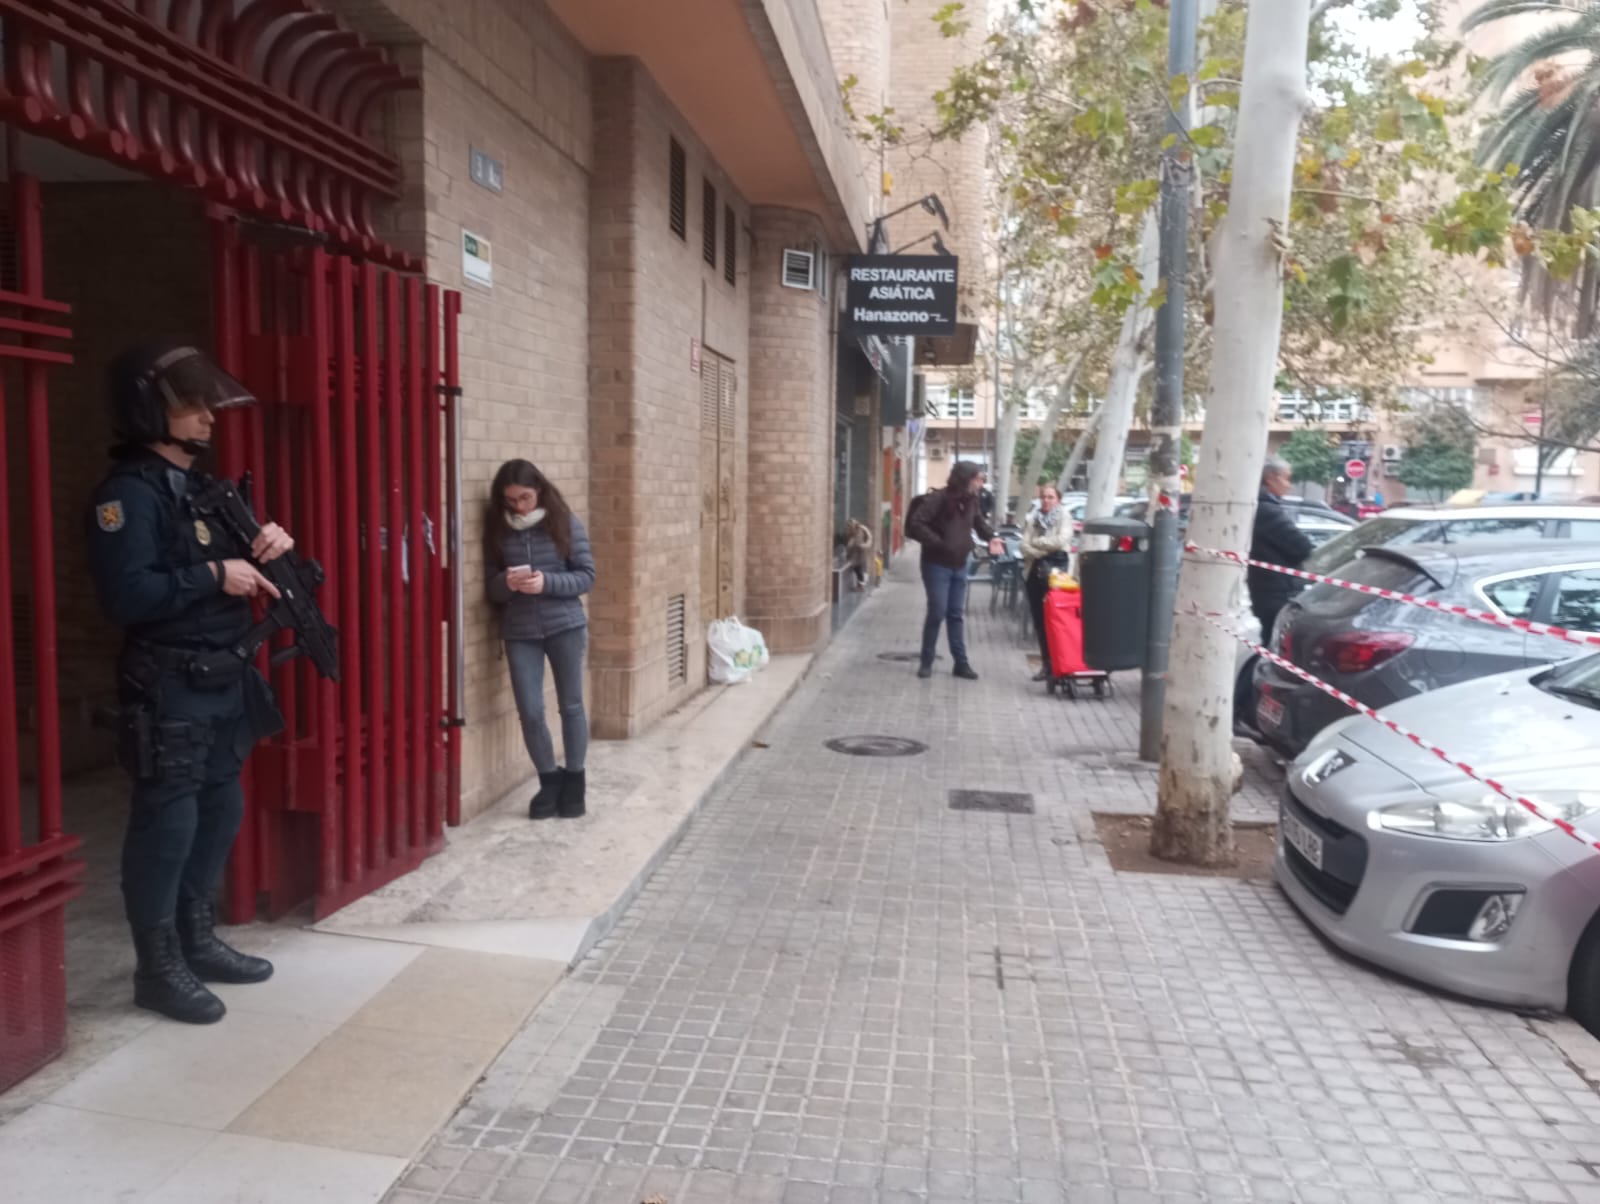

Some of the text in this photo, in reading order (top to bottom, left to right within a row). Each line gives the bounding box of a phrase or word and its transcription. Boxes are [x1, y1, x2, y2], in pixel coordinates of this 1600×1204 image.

[851, 268, 955, 282] RESTAURANTE
[870, 285, 935, 300] ASIÁTICA
[854, 308, 929, 323] Hanazono
